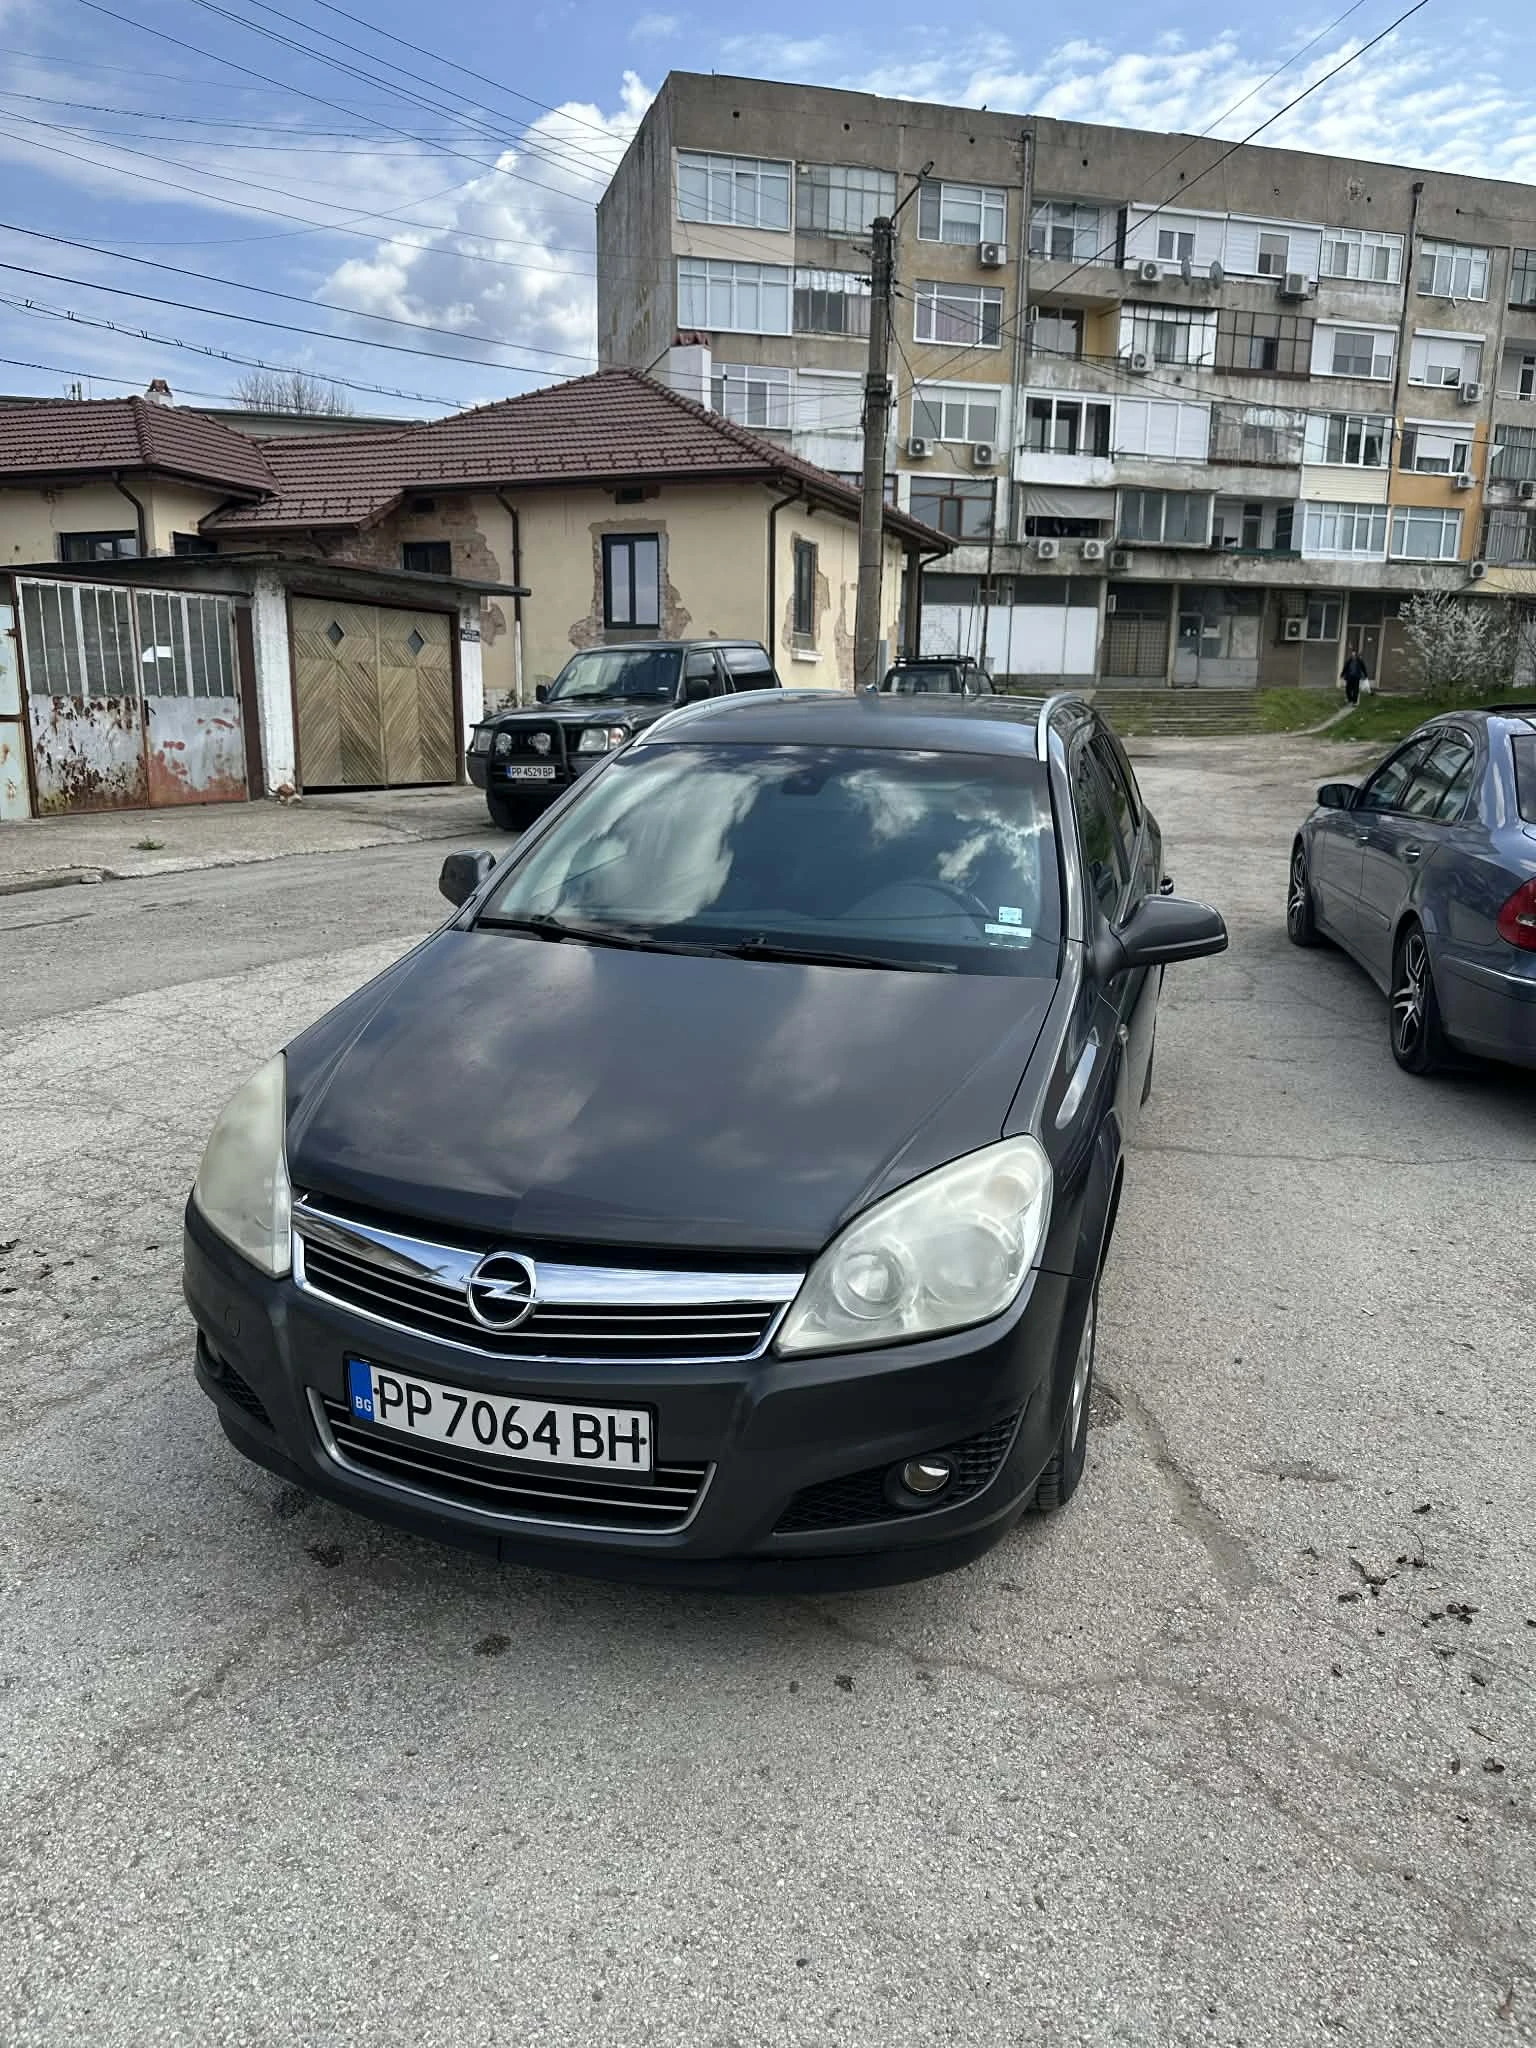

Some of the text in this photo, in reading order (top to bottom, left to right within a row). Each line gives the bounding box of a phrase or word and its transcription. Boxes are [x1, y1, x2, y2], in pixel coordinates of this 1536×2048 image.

[355, 1395, 372, 1413] BG
[378, 1374, 641, 1463] PP 7064 BH
